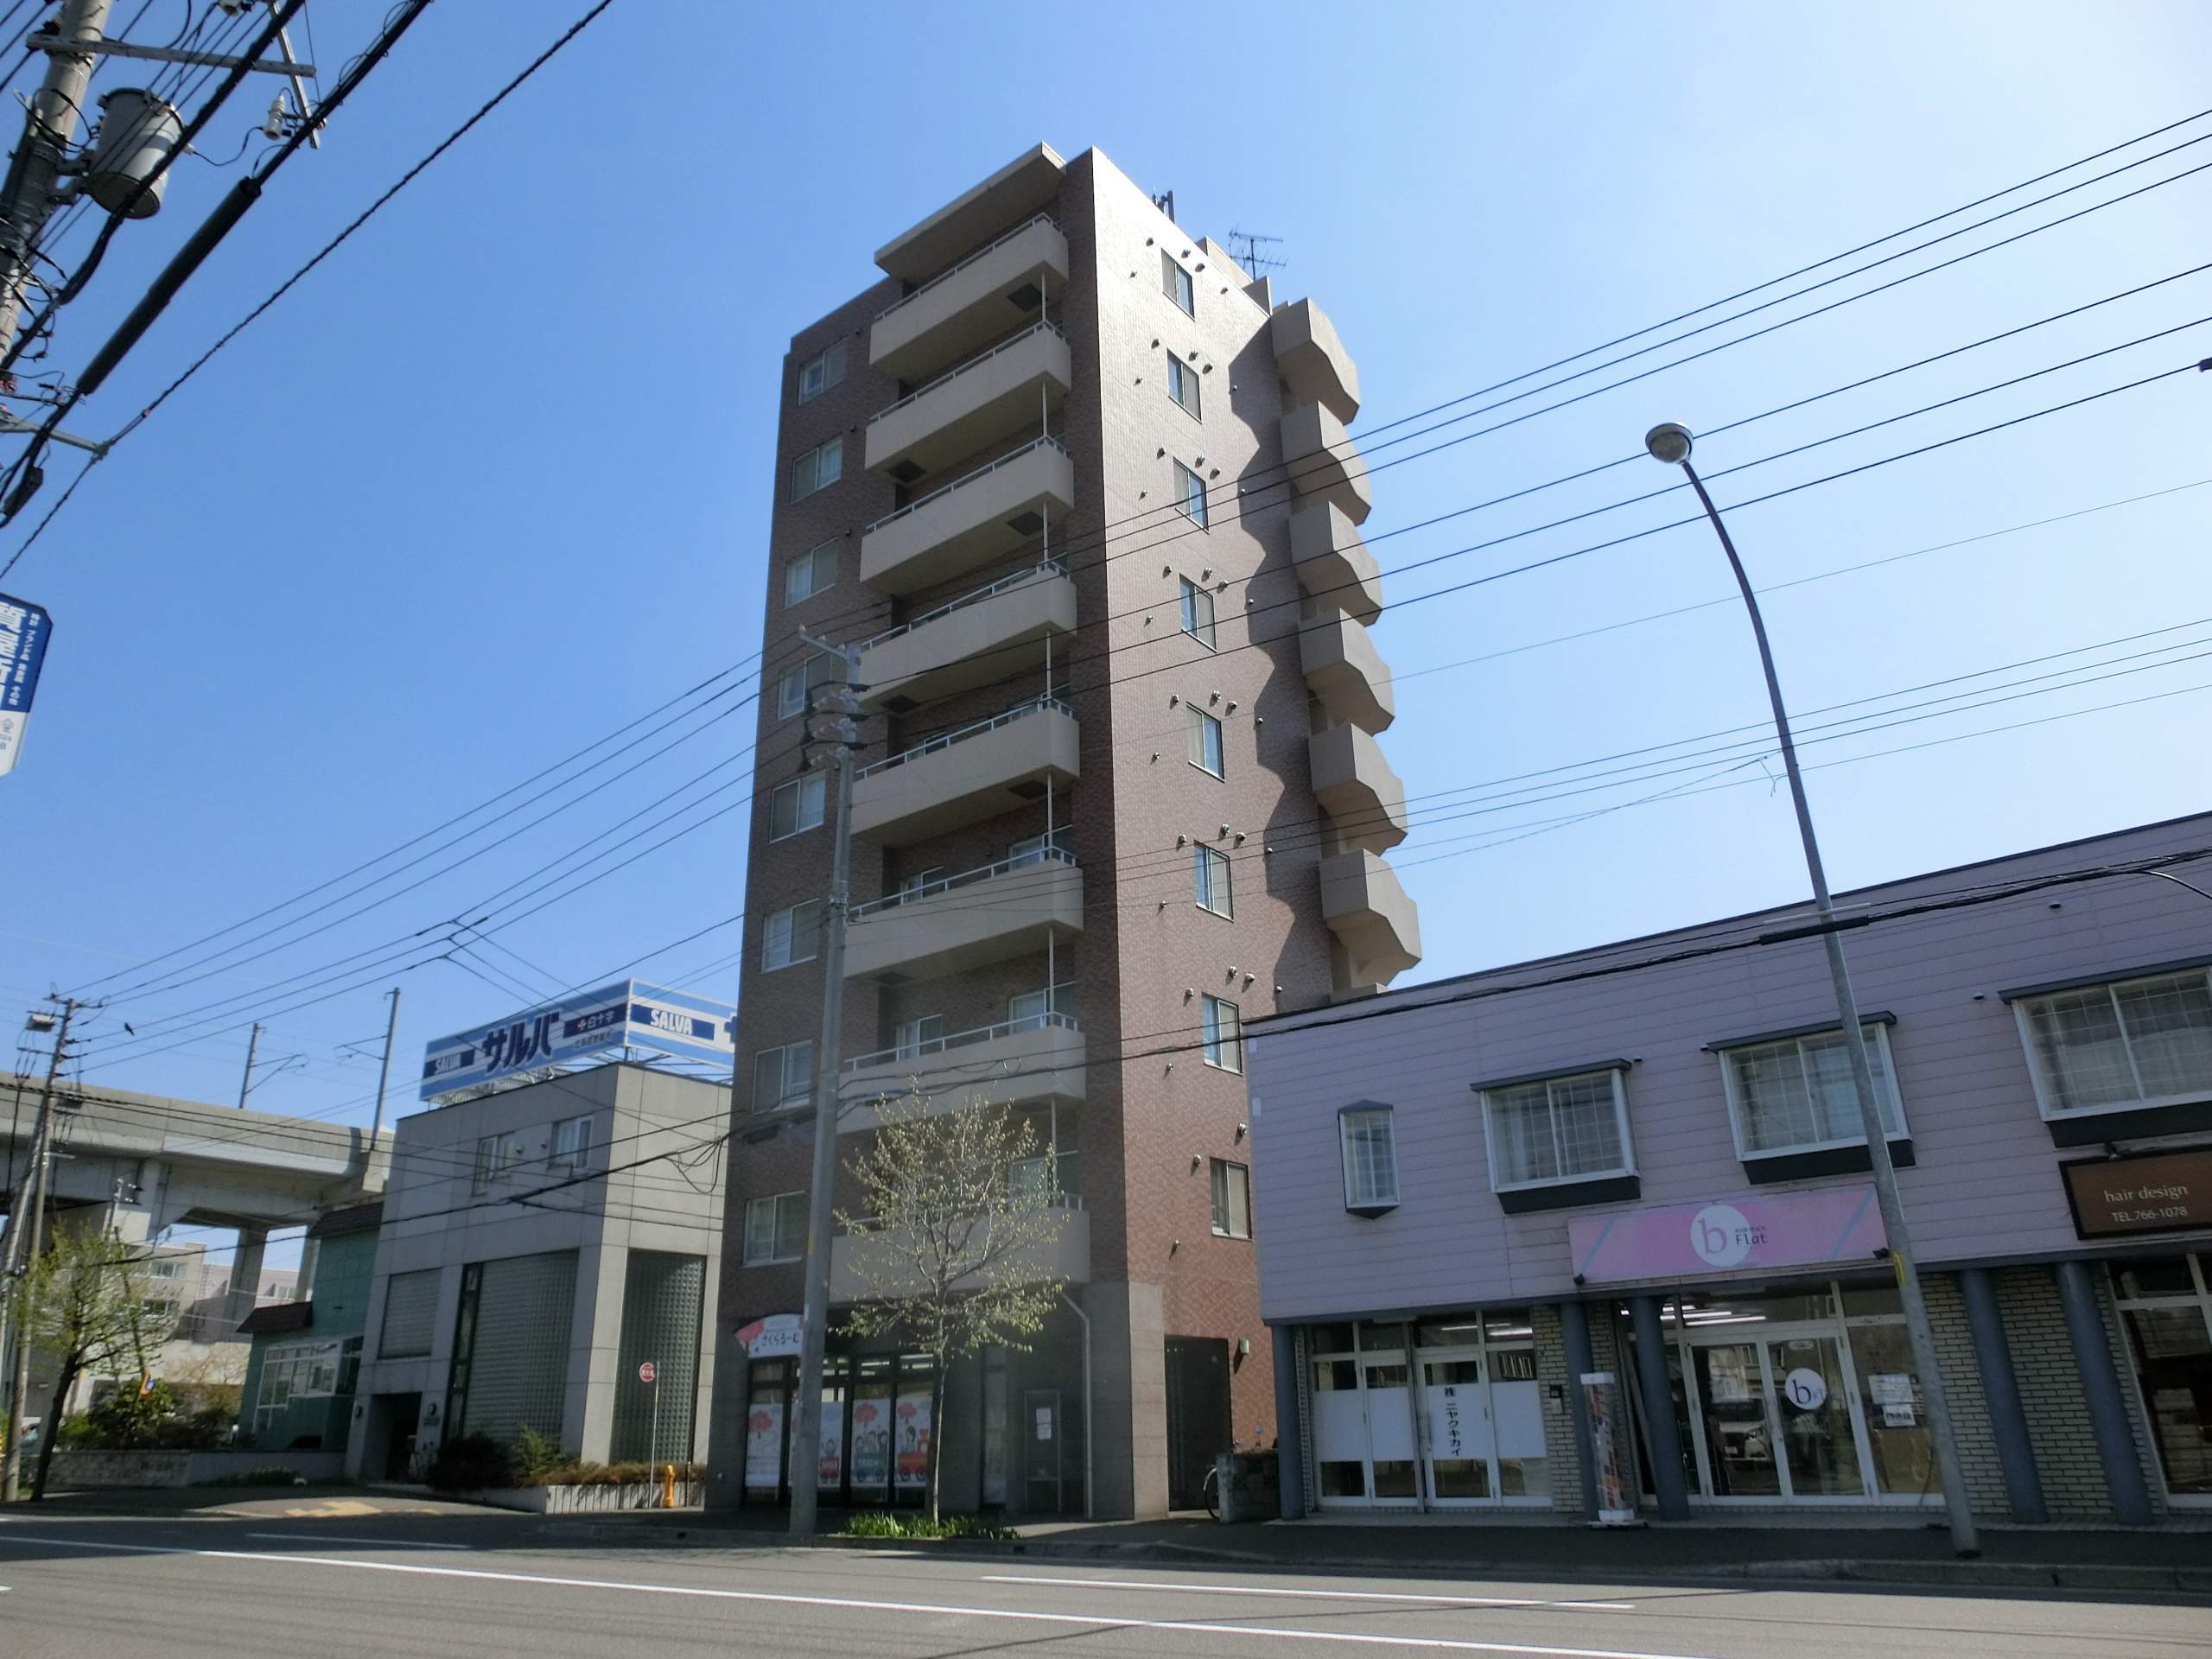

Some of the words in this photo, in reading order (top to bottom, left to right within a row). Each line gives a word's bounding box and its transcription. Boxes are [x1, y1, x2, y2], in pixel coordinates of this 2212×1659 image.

[650, 1008, 692, 1035] SALVA
[435, 1052, 461, 1075] SALVA
[482, 1011, 561, 1077] サルバ
[2104, 1189, 2133, 1203] hair
[2138, 1185, 2189, 1200] design
[2111, 1205, 2189, 1223] TEL.766-1078
[1697, 1218, 1727, 1254] b
[1735, 1233, 1768, 1246] Flat
[761, 1332, 800, 1346] さくらるーむ
[1791, 1379, 1812, 1404] b
